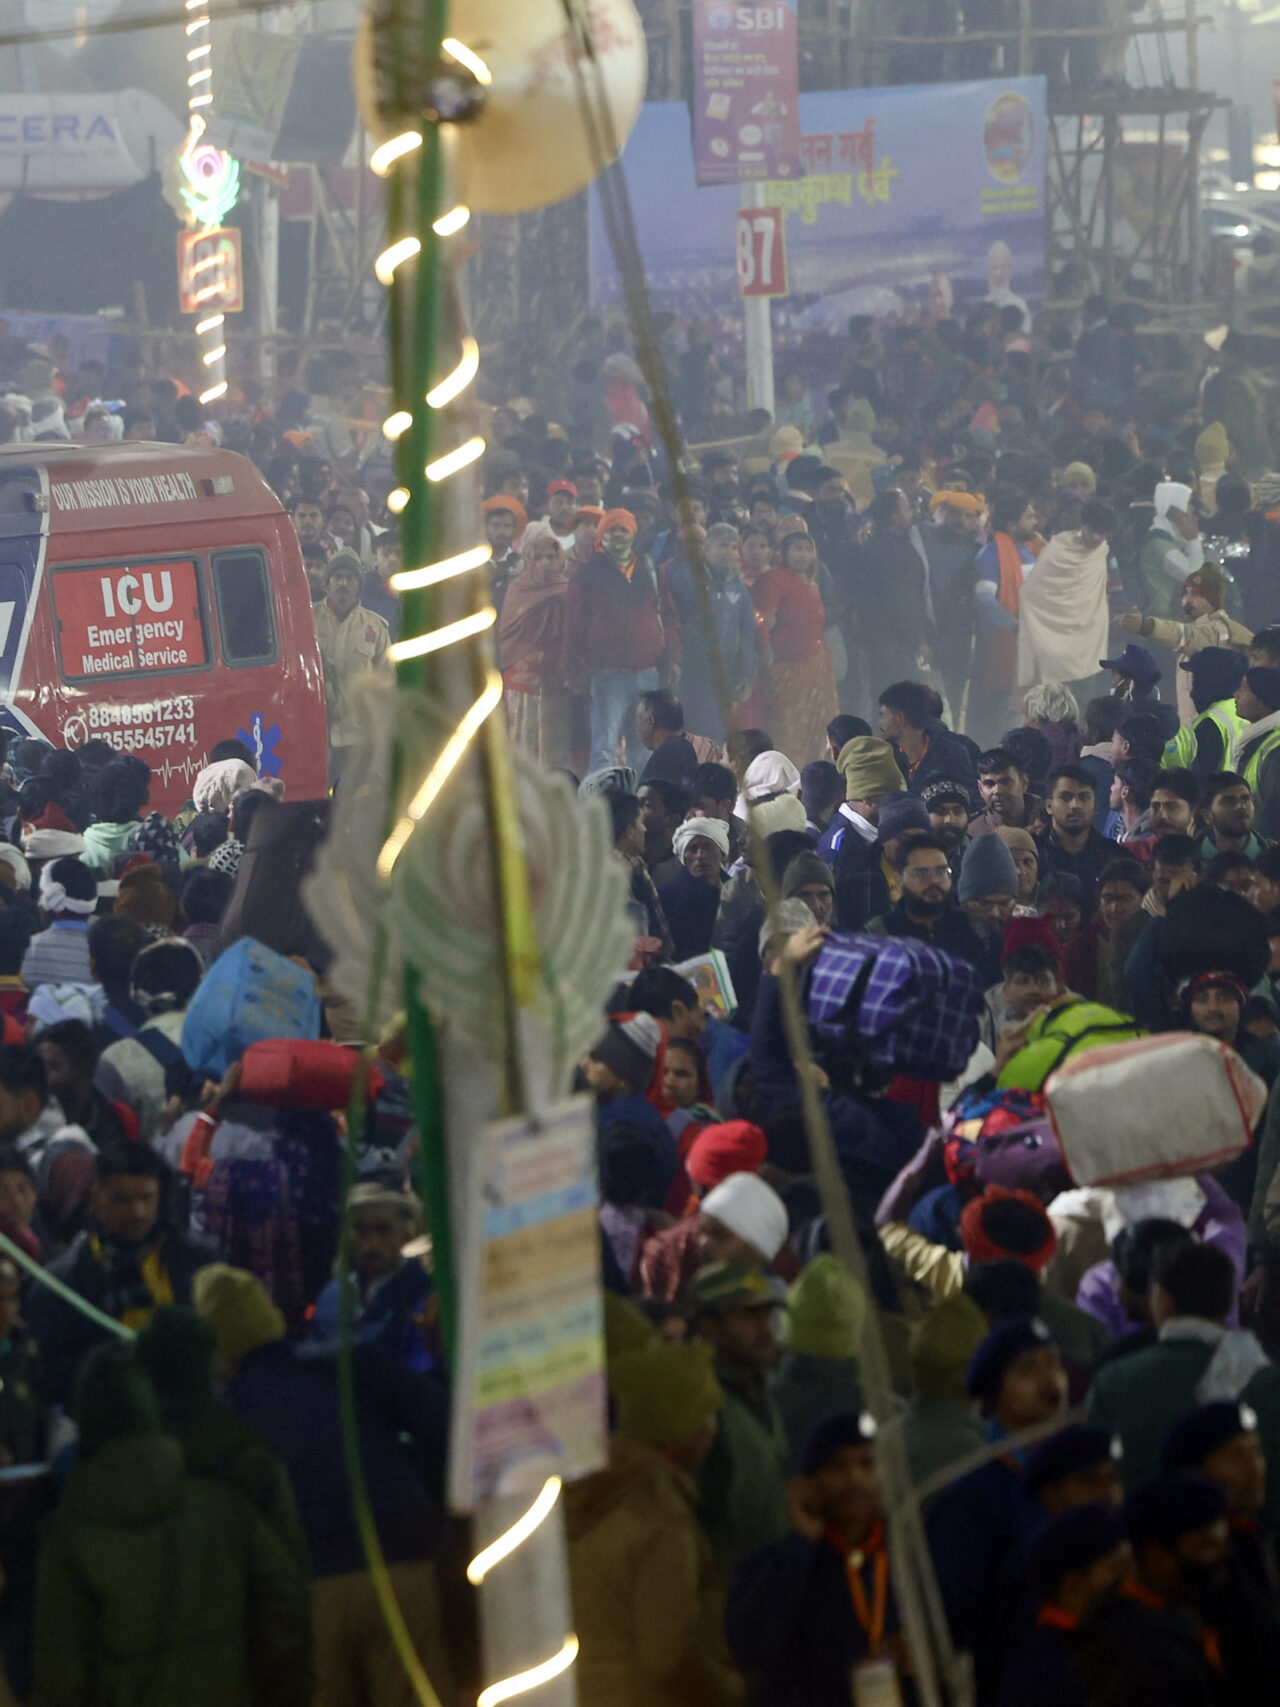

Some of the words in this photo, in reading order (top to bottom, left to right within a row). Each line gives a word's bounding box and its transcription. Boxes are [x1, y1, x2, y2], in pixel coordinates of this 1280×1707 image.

[735, 7, 785, 31] SBI
[51, 482, 79, 511] OUR
[71, 477, 121, 510] MISSION
[114, 477, 132, 506] IS
[128, 476, 160, 506] YOUR
[152, 471, 198, 504] HEALTH
[100, 570, 174, 618] ICU
[87, 620, 184, 648] Emergency
[82, 650, 134, 674] Medical
[137, 646, 188, 668] Service
[90, 722, 196, 751] 355545741
